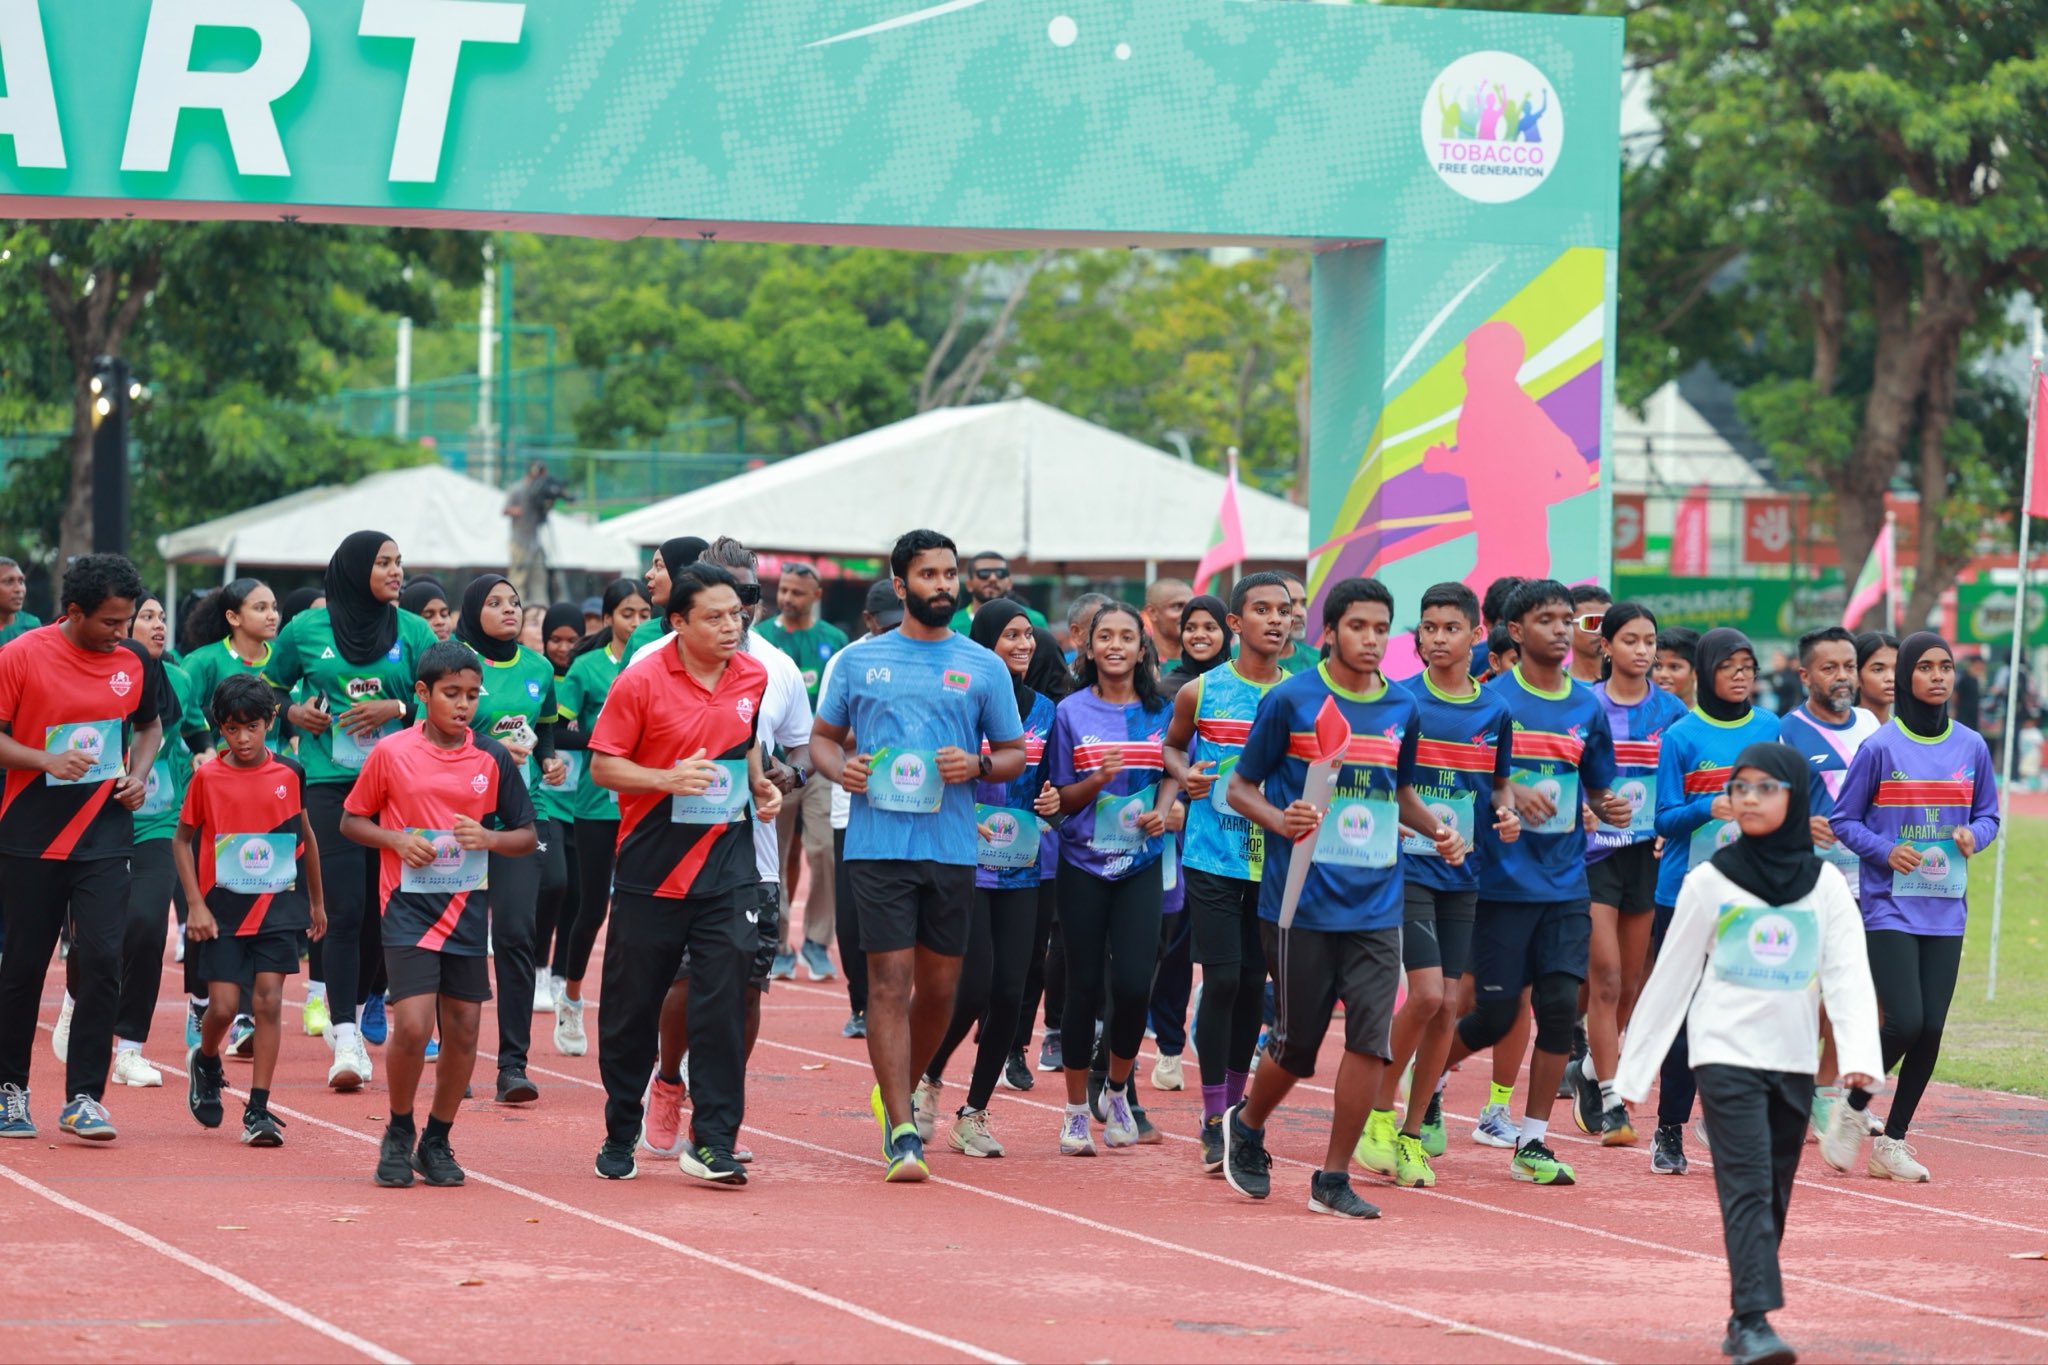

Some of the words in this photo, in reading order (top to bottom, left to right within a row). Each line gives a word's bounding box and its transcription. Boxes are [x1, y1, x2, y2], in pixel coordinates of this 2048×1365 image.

[1439, 142, 1544, 164] TOBACCO
[1438, 163, 1468, 174] FREE
[1471, 164, 1544, 177] GENERATION
[496, 720, 523, 731] MILO
[1354, 768, 1372, 788] THE
[1438, 770, 1456, 787] THE
[1924, 808, 1940, 823] THE
[1239, 836, 1262, 853] SHOP
[1104, 856, 1134, 872] SHOP
